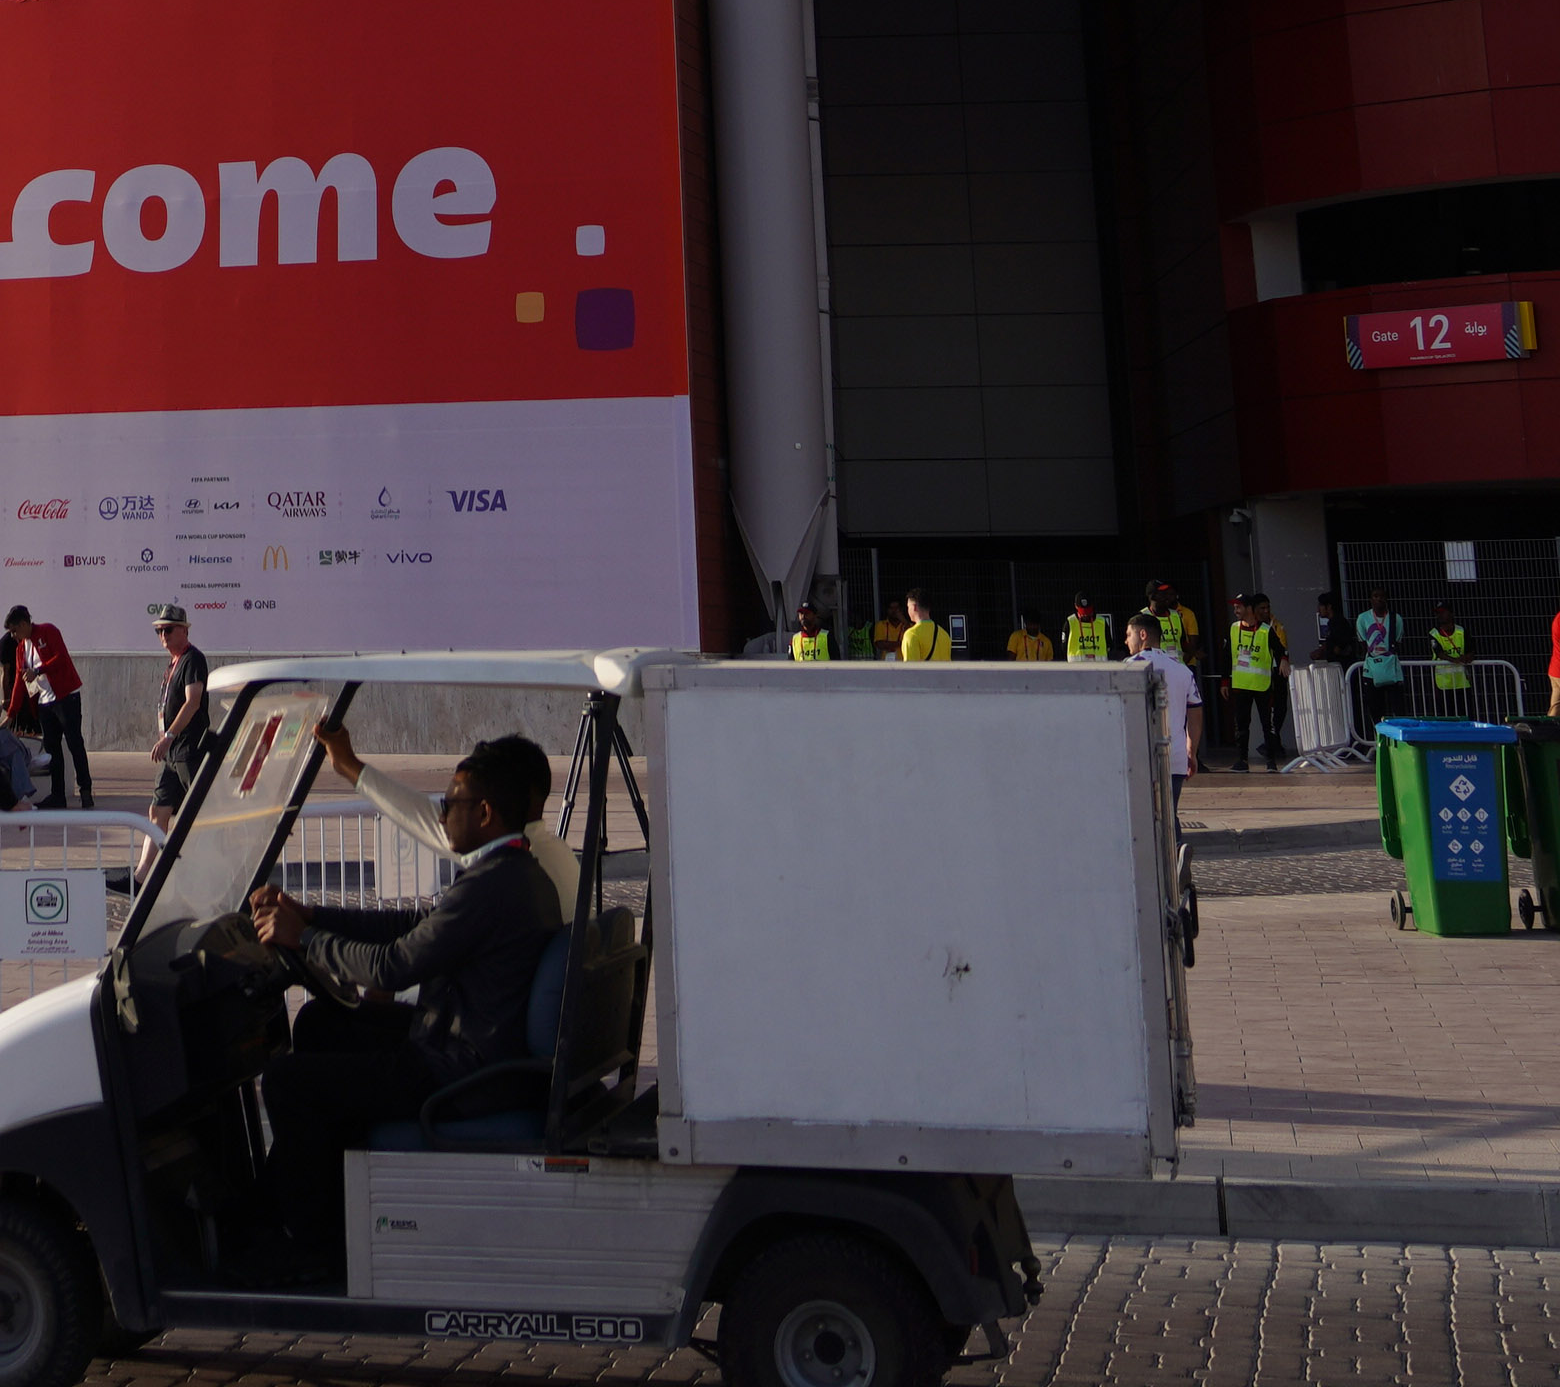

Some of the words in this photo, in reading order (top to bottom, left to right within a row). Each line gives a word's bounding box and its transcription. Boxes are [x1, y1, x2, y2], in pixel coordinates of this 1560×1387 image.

[1372, 330, 1399, 343] Gate
[1410, 315, 1452, 350] 12
[1464, 322, 1487, 336] بوابة
[121, 495, 155, 511] 万达
[267, 491, 326, 510] QATAR
[446, 489, 508, 512] VISA
[122, 511, 154, 520] WANDA
[282, 507, 327, 518] AIRWAYS
[3, 556, 44, 568] Budweiser
[75, 555, 106, 566] BYJU'S
[188, 554, 233, 564] Hisense
[386, 550, 432, 564] vivo
[126, 564, 169, 573] crypto.com
[254, 600, 276, 610] QNB
[425, 1310, 569, 1340] CARRYALL
[572, 1315, 643, 1342] 500
